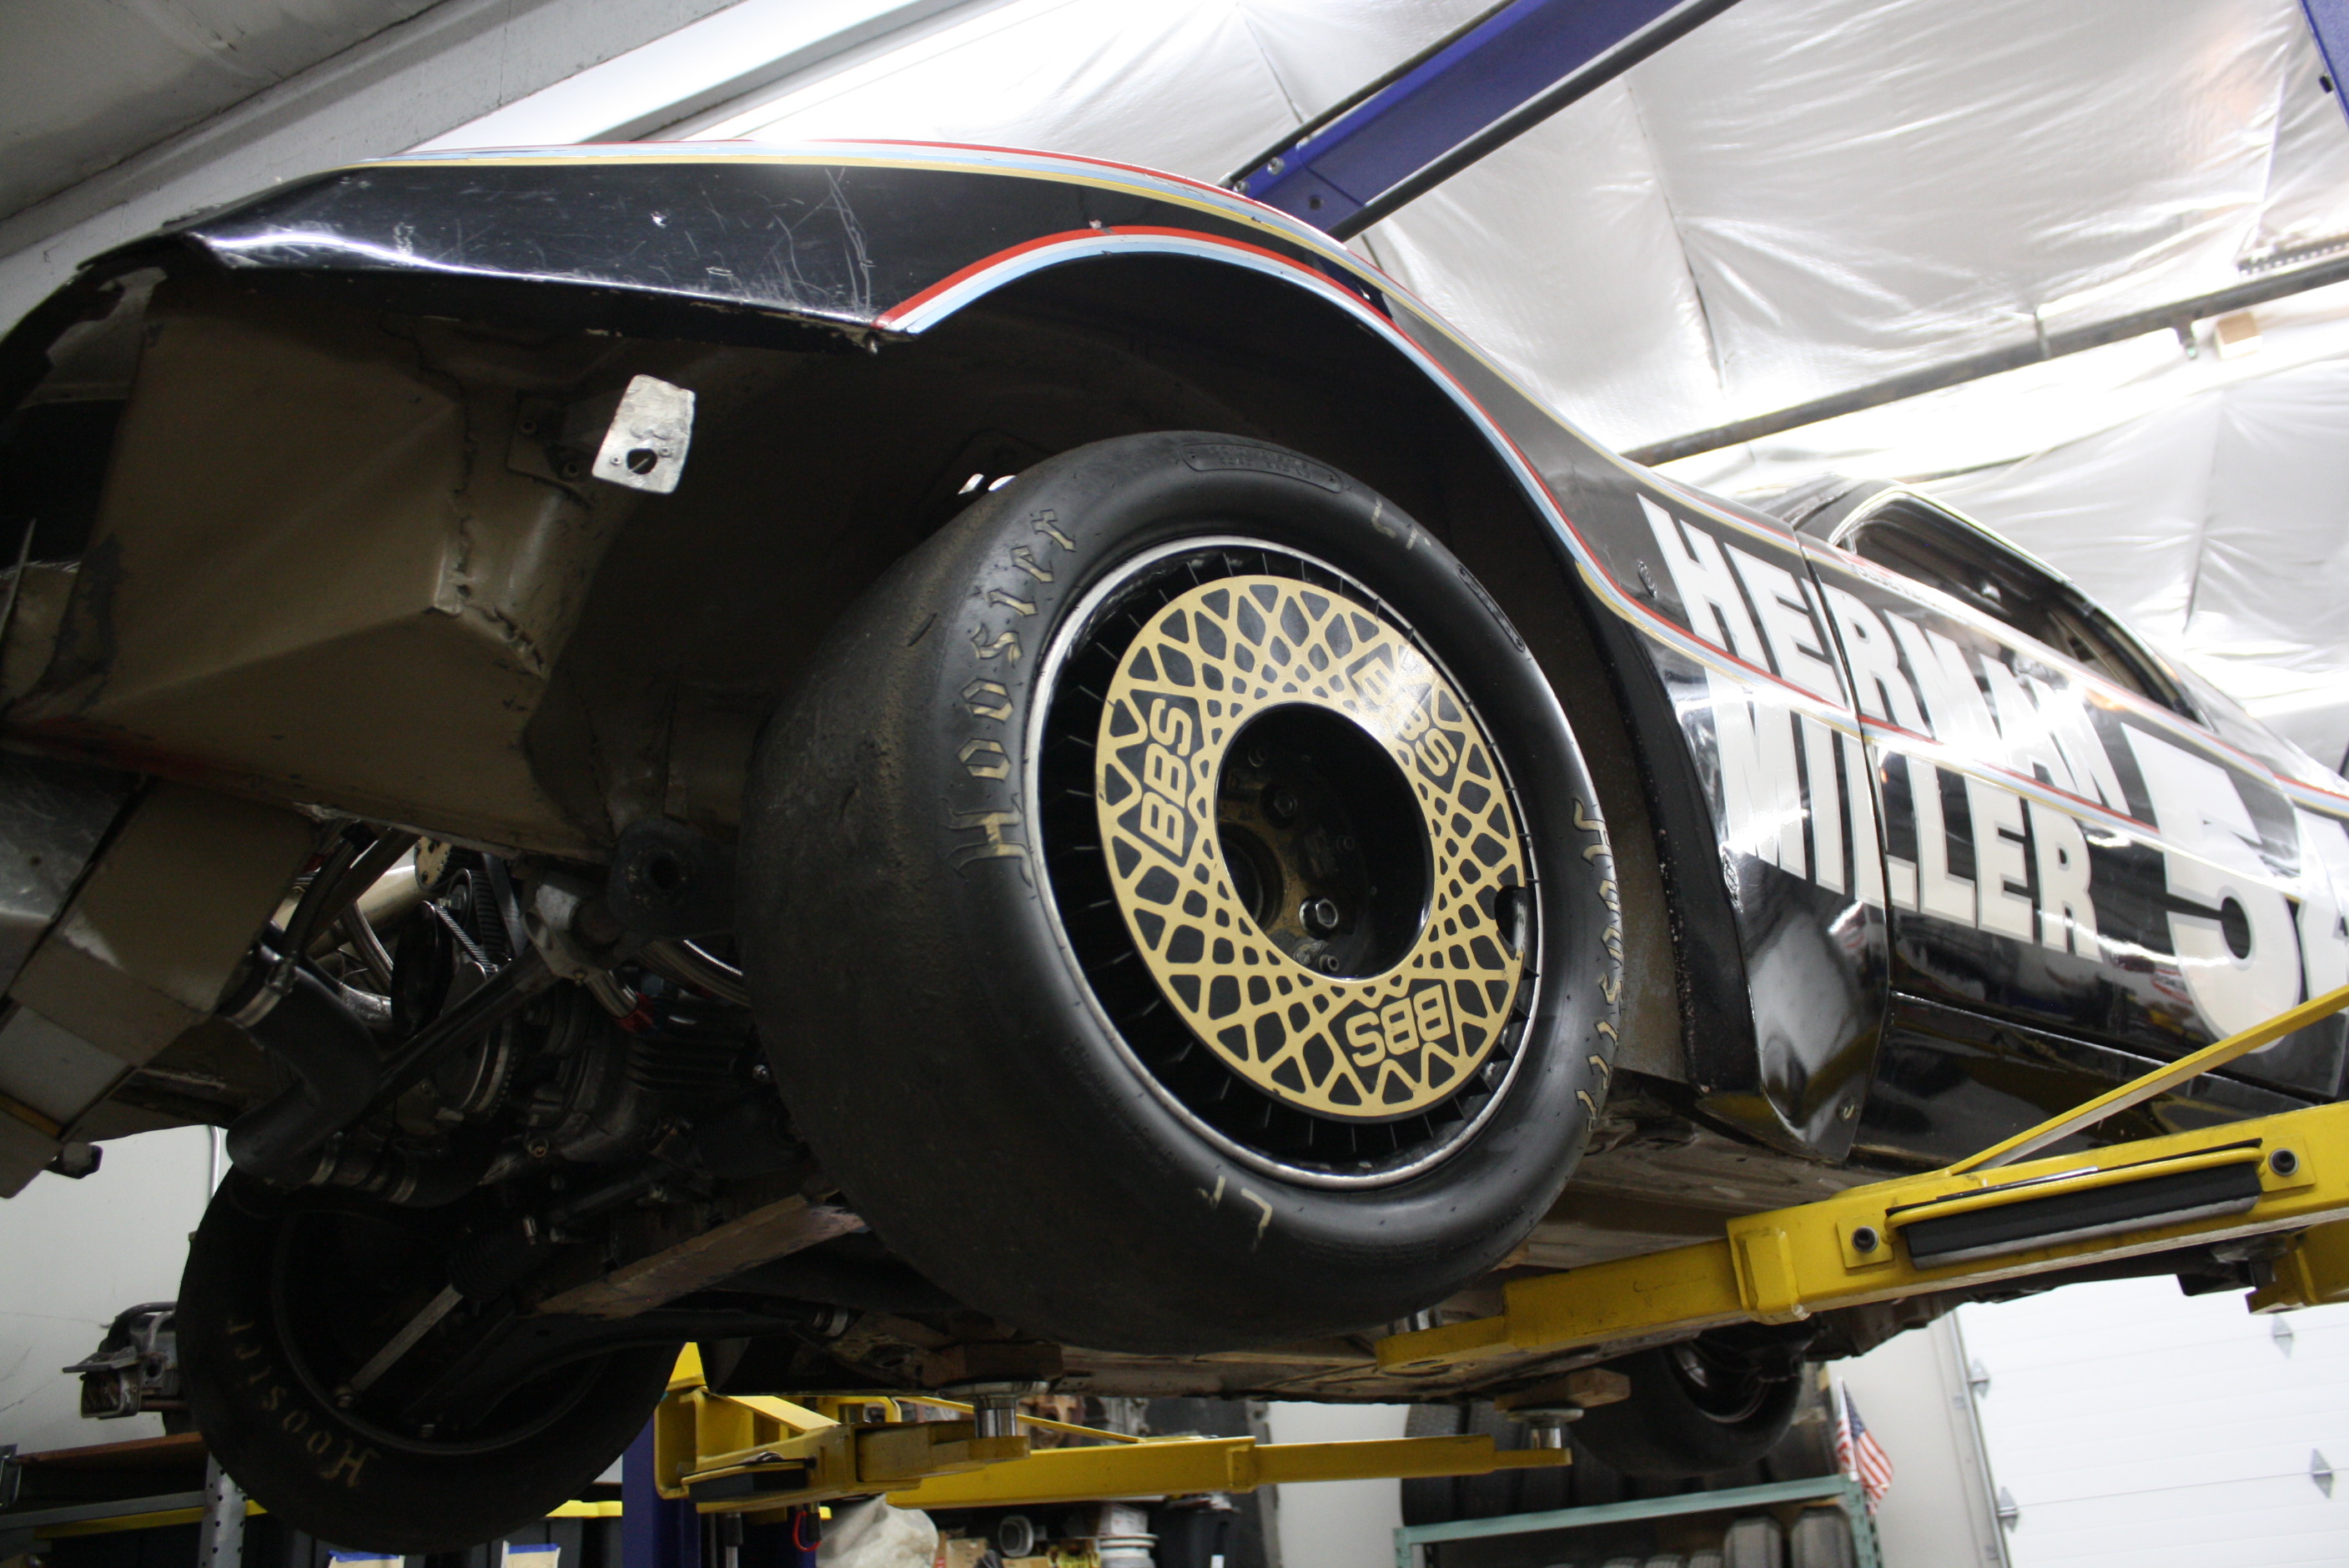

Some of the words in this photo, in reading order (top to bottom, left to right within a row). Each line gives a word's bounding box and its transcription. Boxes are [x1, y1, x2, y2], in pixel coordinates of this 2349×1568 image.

[939, 508, 1077, 889] Hoosier
[1351, 652, 1458, 781] BBS
[1637, 492, 2132, 817] HERMAN
[1139, 696, 1193, 859] BBS
[1704, 666, 2103, 962] MILLER
[1346, 984, 1452, 1068] BBS
